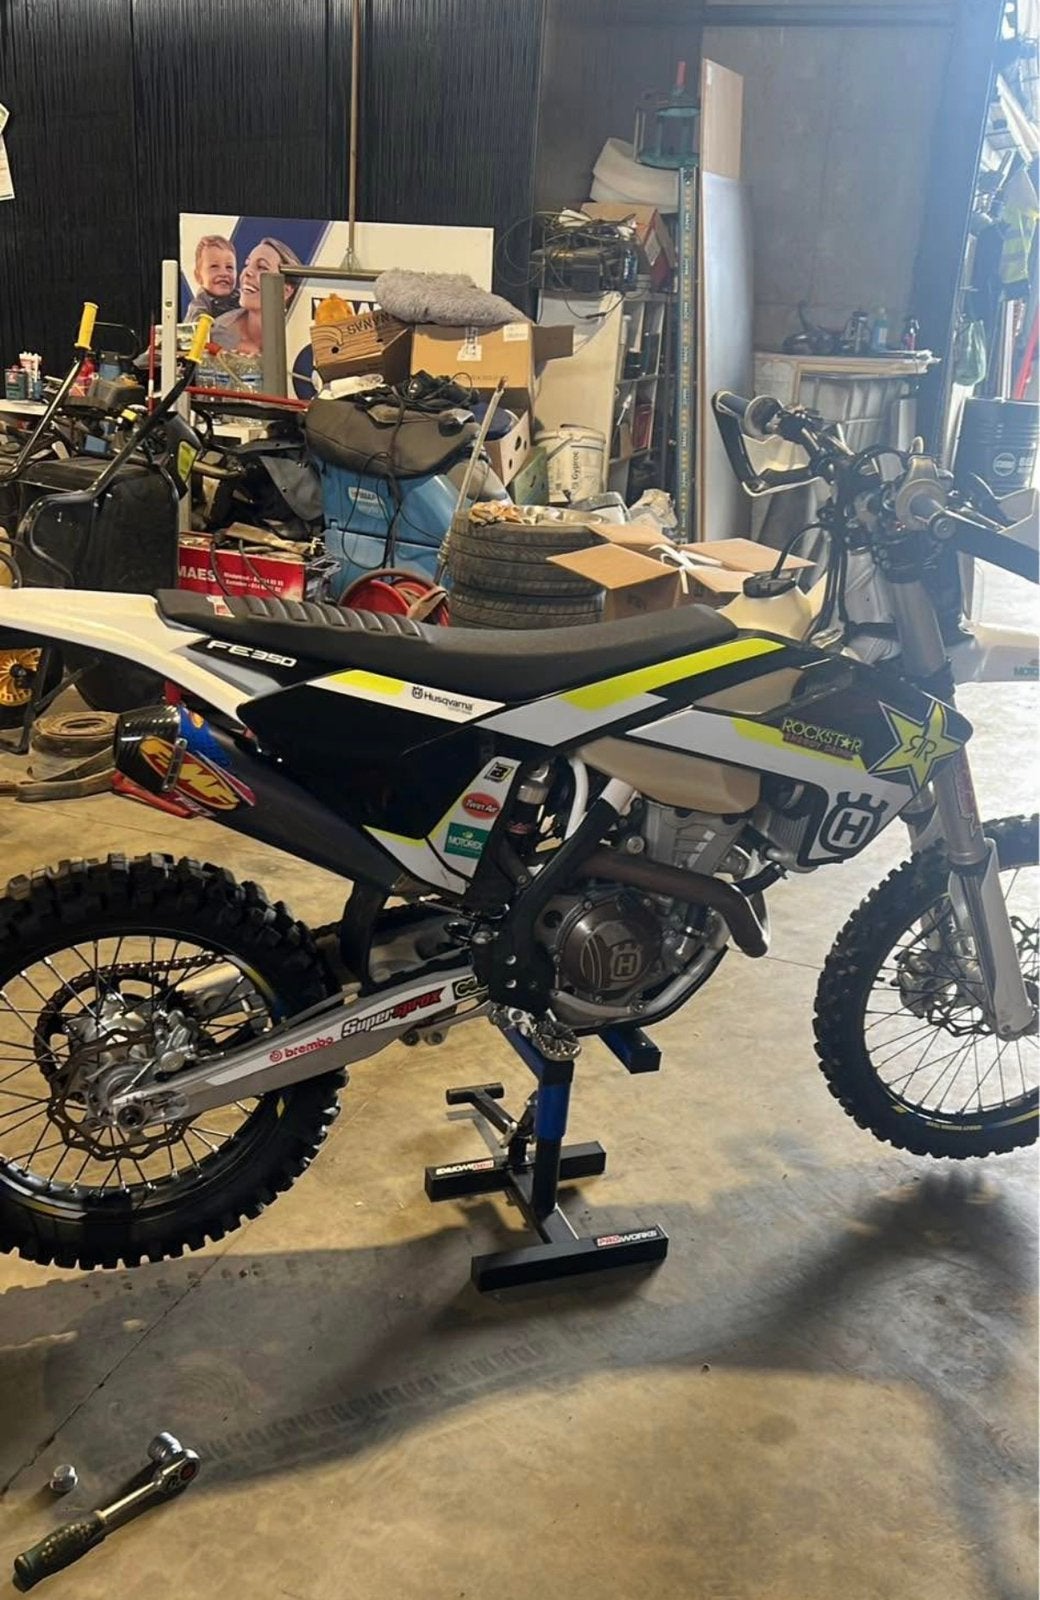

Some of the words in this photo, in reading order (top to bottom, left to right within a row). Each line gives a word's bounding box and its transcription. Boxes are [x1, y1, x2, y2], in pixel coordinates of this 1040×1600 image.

[206, 640, 298, 668] FE350
[424, 691, 473, 711] Husqvarna
[449, 836, 483, 850] MOTOREX
[285, 1037, 334, 1058] brembo
